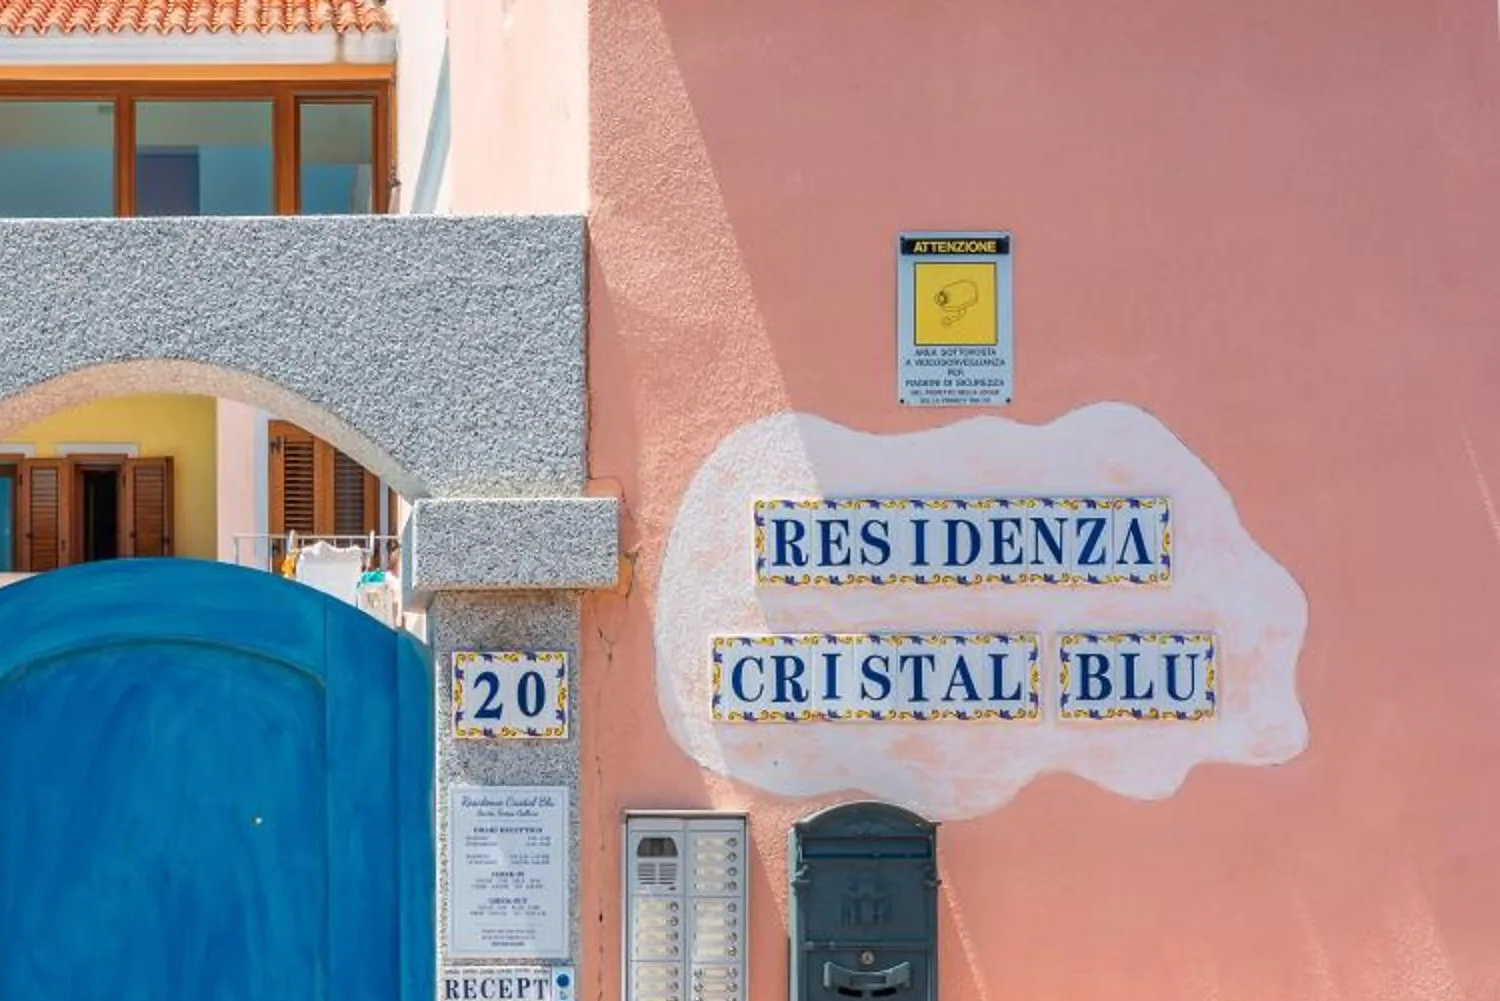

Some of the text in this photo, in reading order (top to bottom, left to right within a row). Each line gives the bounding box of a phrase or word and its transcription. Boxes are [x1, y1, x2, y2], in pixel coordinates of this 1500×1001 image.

[913, 240, 997, 253] ATTENZIONE
[771, 517, 1156, 568] RESIDENZA
[473, 671, 546, 720] 20
[731, 652, 1200, 703] CRISTAL BLU
[445, 978, 549, 1000] RECEPT
